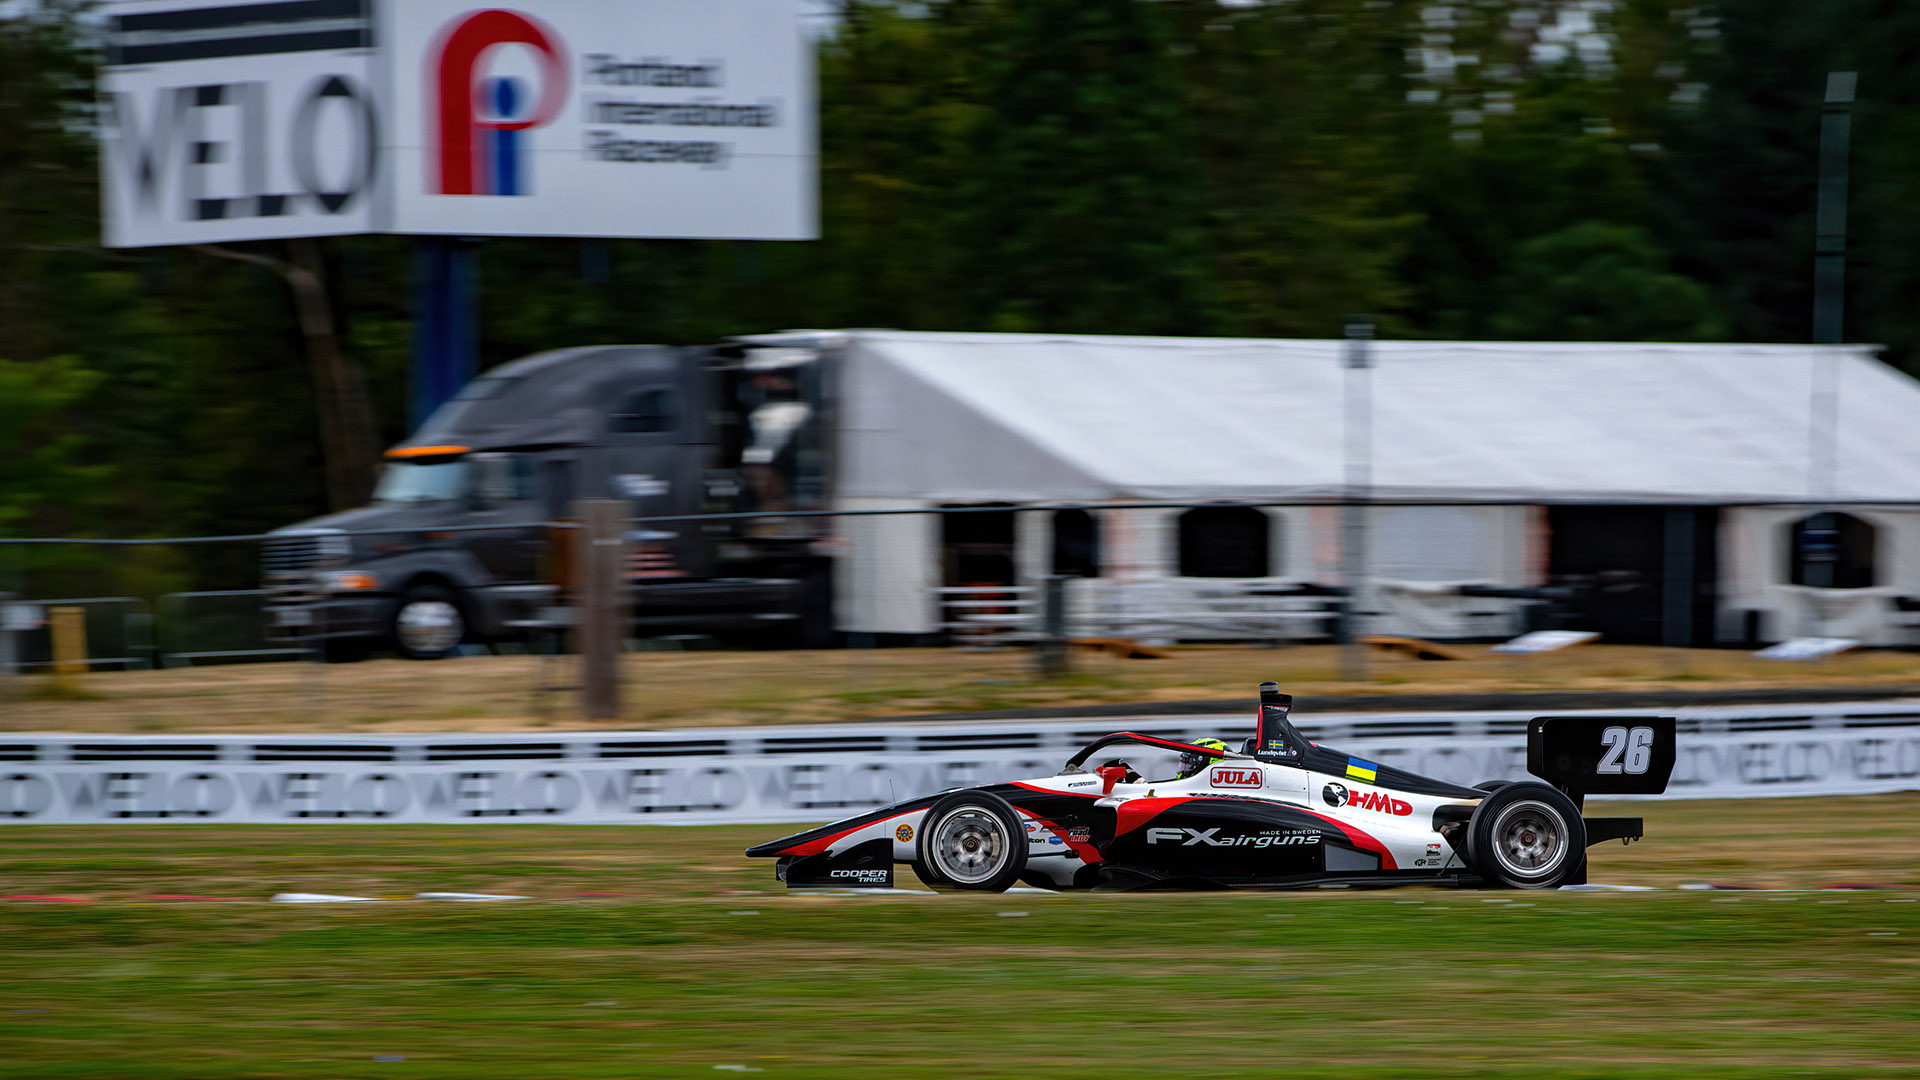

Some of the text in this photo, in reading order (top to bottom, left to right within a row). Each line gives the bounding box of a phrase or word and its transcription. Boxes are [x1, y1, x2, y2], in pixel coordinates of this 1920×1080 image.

[582, 54, 724, 87] Portland
[582, 92, 783, 127] International
[102, 74, 381, 217] VELO
[582, 130, 733, 169] Raceway
[1257, 749, 1287, 757] Lundqvist
[1597, 726, 1654, 774] 26
[1212, 770, 1260, 785] JULA
[1346, 789, 1413, 816] HMD
